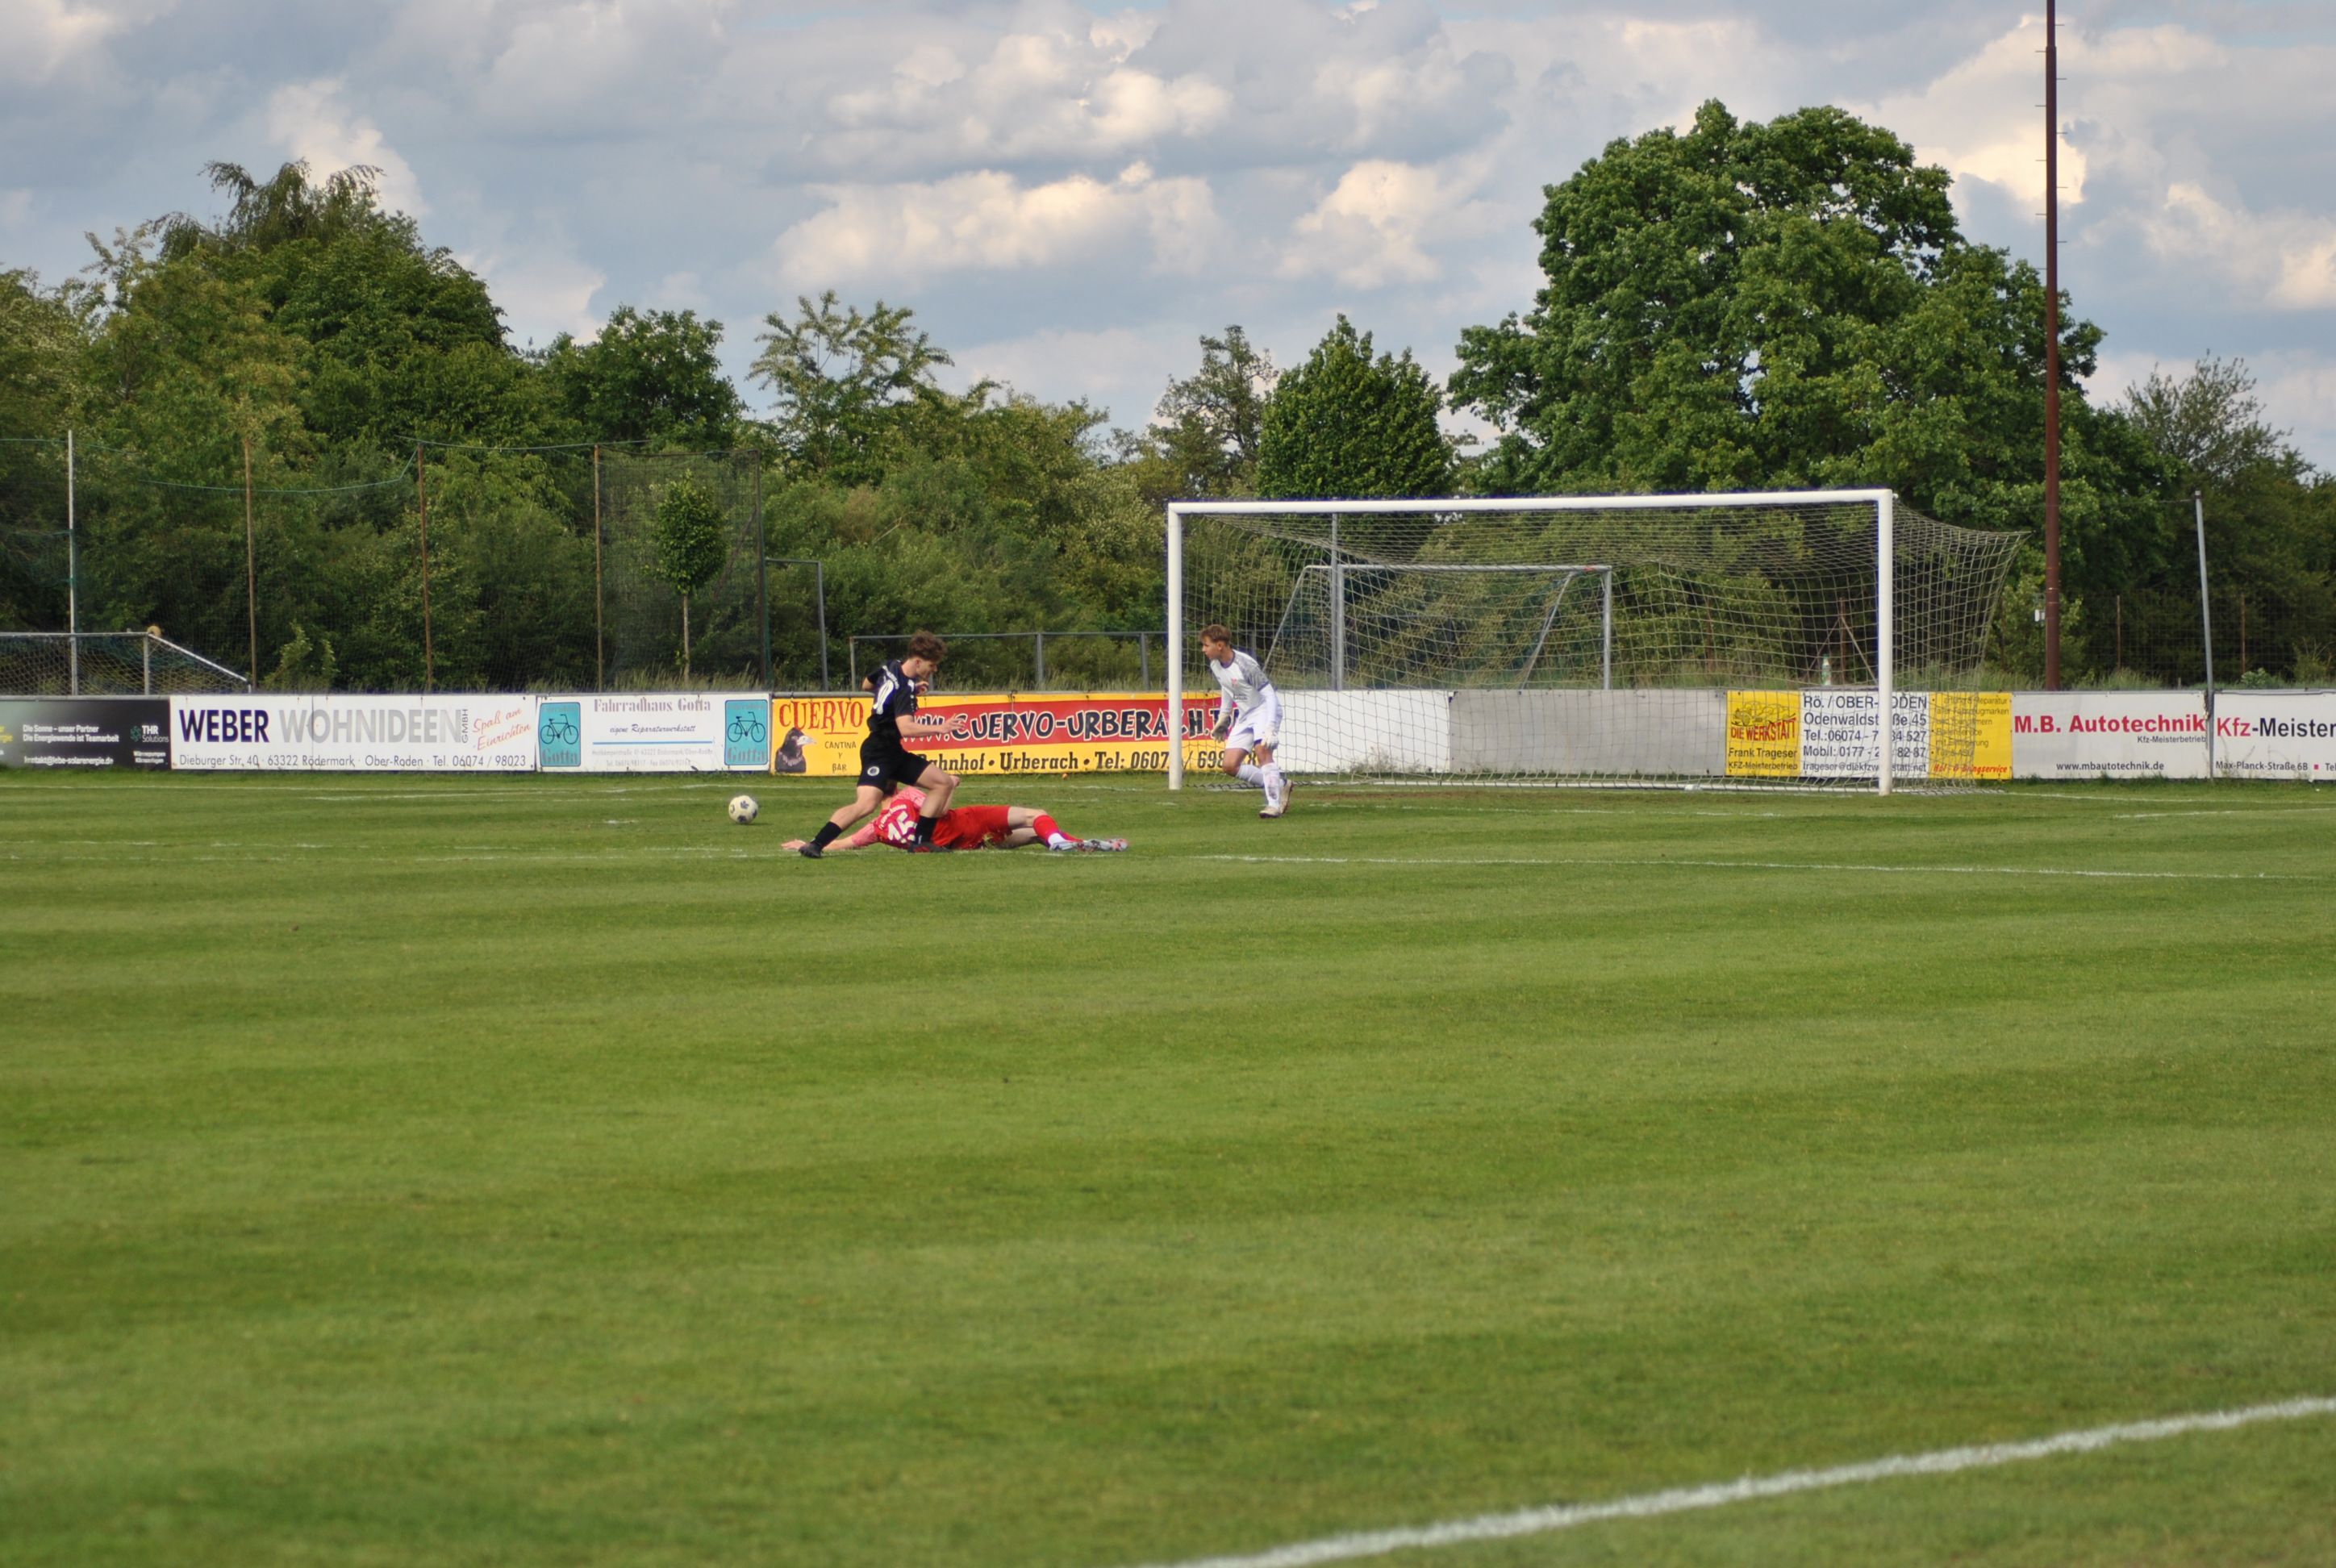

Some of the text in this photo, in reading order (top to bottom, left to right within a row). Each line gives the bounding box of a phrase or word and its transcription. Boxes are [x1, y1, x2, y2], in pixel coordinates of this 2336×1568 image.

[594, 697, 711, 712] Fahrradhaus Gotta
[1804, 696, 1825, 708] Rö.
[472, 708, 522, 734] Spaß am
[778, 700, 864, 732] CUERVO
[1804, 713, 1927, 726] Odenwaldstße 45
[23, 724, 33, 732] Die
[34, 724, 52, 732] Sonne
[76, 724, 99, 732] Partner
[178, 709, 270, 743] WEBER
[278, 709, 461, 744] WOHNIDEEN
[1730, 717, 1796, 741] DIE WERKSTATT
[2014, 714, 2207, 732] M.B. Autotechnik
[142, 725, 159, 734] THR
[610, 724, 696, 735] eigene Reparaturwerkstatt
[34, 733, 76, 744] Energiewende
[86, 734, 119, 742] Teamarbeit
[478, 724, 532, 751] Einrichten
[1907, 731, 1927, 741] 527
[824, 741, 857, 749] CANTINA
[541, 748, 578, 765] Gotta
[728, 746, 765, 762] Gotta
[1729, 748, 1798, 760] Frank Trageser
[1803, 746, 1837, 757] Mobil:
[1839, 746, 1864, 757] 0177
[1897, 747, 1910, 757] 82
[1913, 748, 1926, 757] 87
[180, 754, 226, 768] Dieburger
[247, 755, 260, 766] 40
[268, 755, 298, 766] 63322
[302, 754, 355, 766] Rödermark
[365, 755, 423, 766] Ober-Roden
[433, 755, 448, 766] Tel.
[453, 755, 483, 766] 06074
[495, 755, 526, 766] 98023
[917, 753, 985, 771] hnhof
[999, 752, 1078, 770] Urberach
[1095, 752, 1125, 769] Tel:
[1130, 751, 1169, 769] 0607
[1728, 761, 1798, 769] KFZ-Meisterbetrieb
[2056, 761, 2165, 770] www.mbautotechnik.de
[2216, 761, 2296, 771] Max-Planck-Straße
[2297, 761, 2309, 771] 6B
[832, 764, 847, 772] BAR
